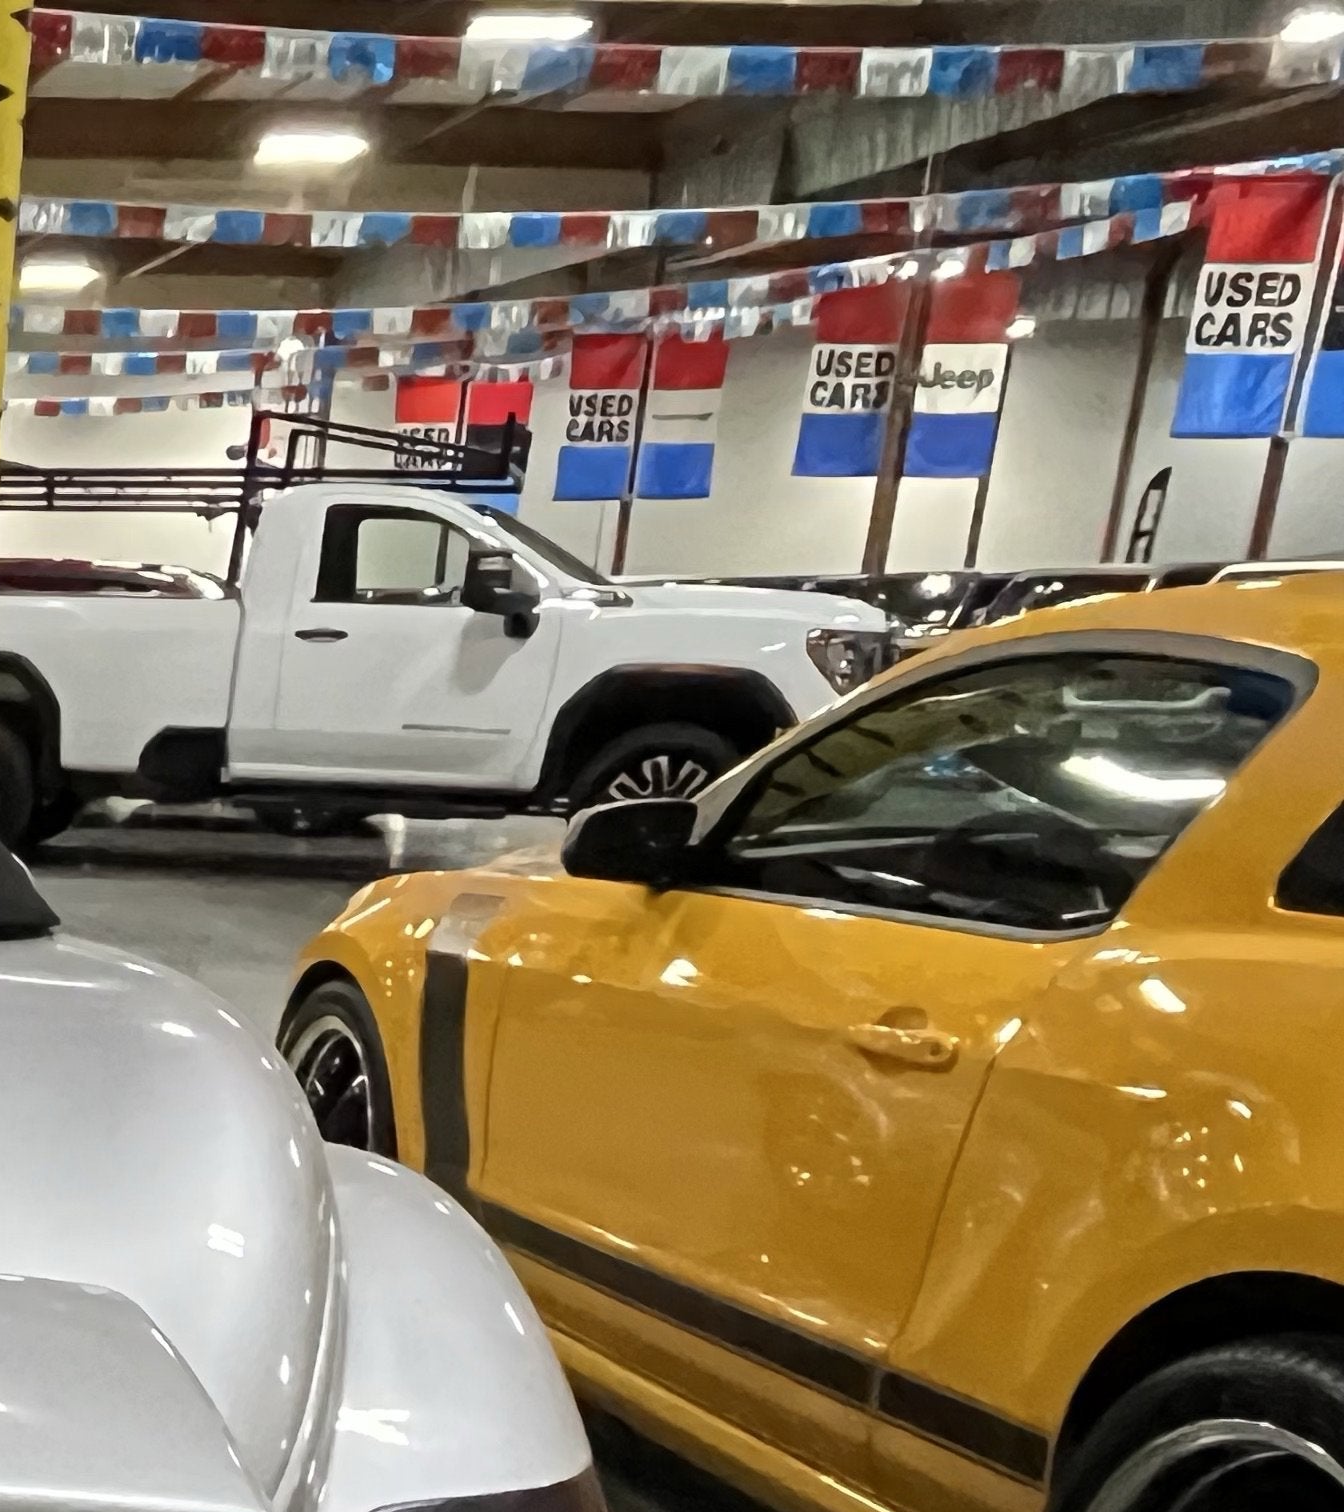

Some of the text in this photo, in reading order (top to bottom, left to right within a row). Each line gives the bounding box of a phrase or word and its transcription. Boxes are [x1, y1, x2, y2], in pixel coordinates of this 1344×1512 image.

[1205, 271, 1301, 307] USED
[1195, 312, 1293, 347] CARS
[816, 349, 895, 378] USED
[916, 361, 995, 394] Jeep
[569, 393, 633, 417] USED
[810, 380, 890, 409] CARS
[566, 419, 629, 442] CARS
